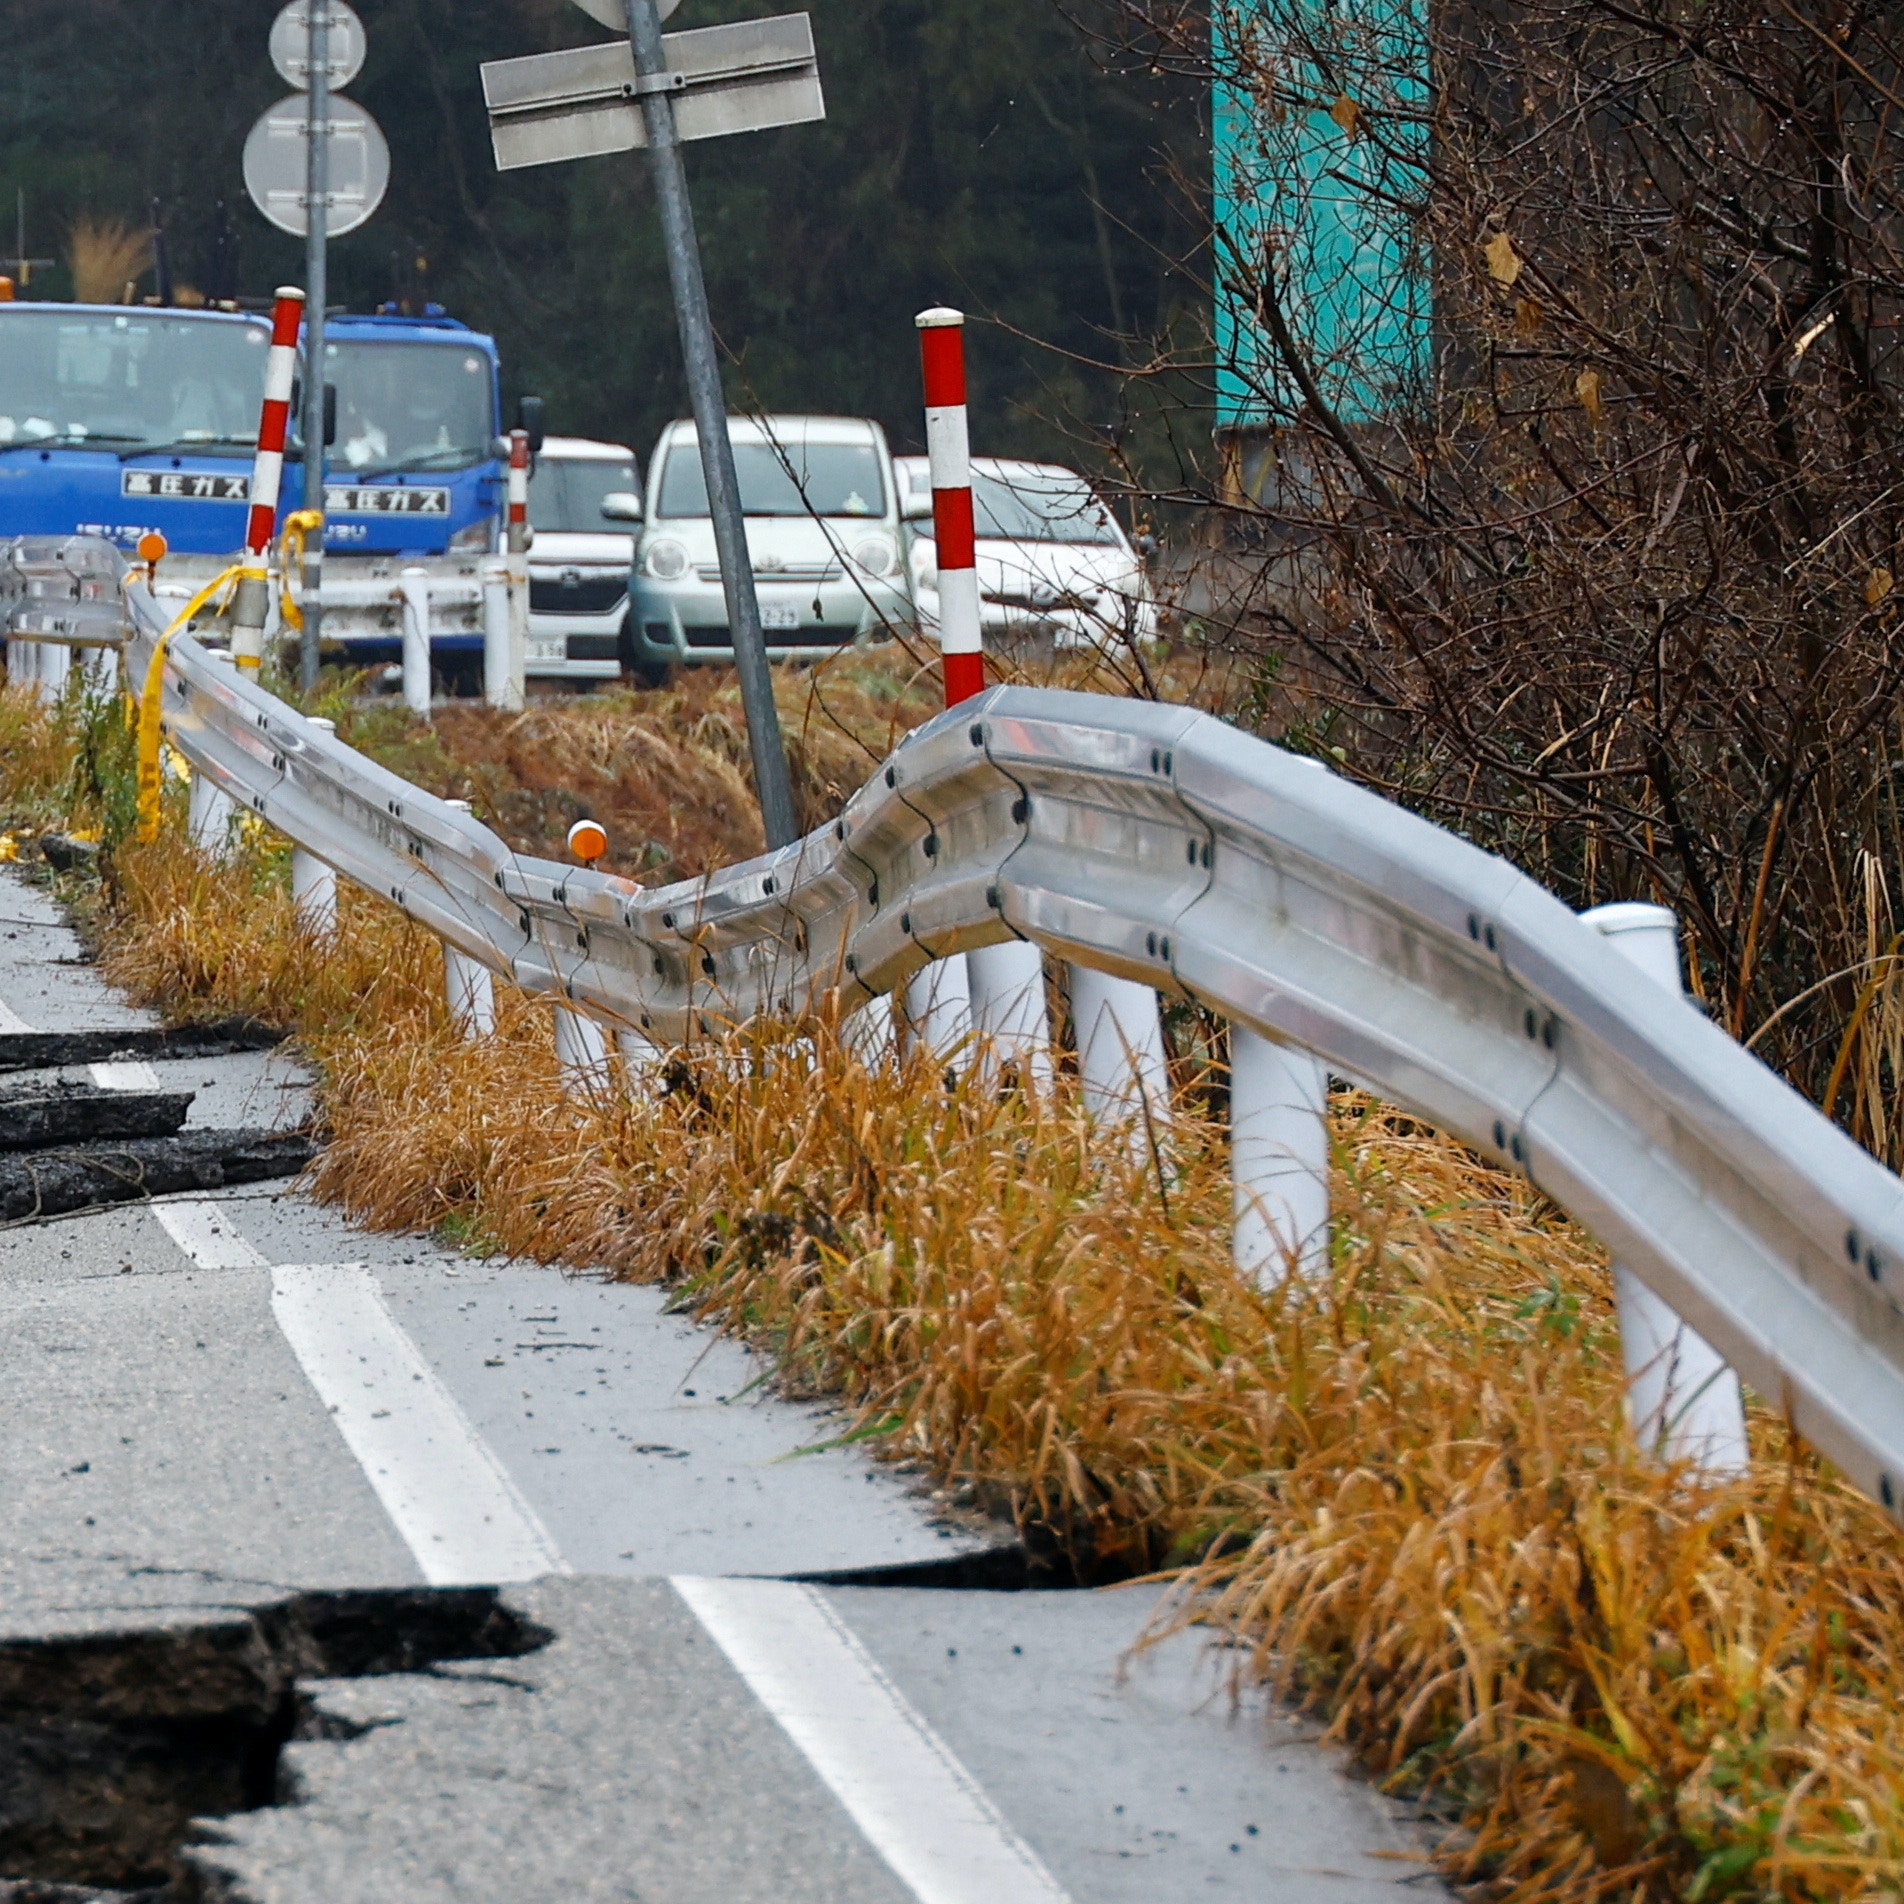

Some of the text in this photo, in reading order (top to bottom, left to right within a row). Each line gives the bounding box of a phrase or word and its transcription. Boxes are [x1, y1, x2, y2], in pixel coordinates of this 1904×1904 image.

[126, 473, 245, 499] 高圧ガス
[324, 489, 442, 512] 高圧ガス
